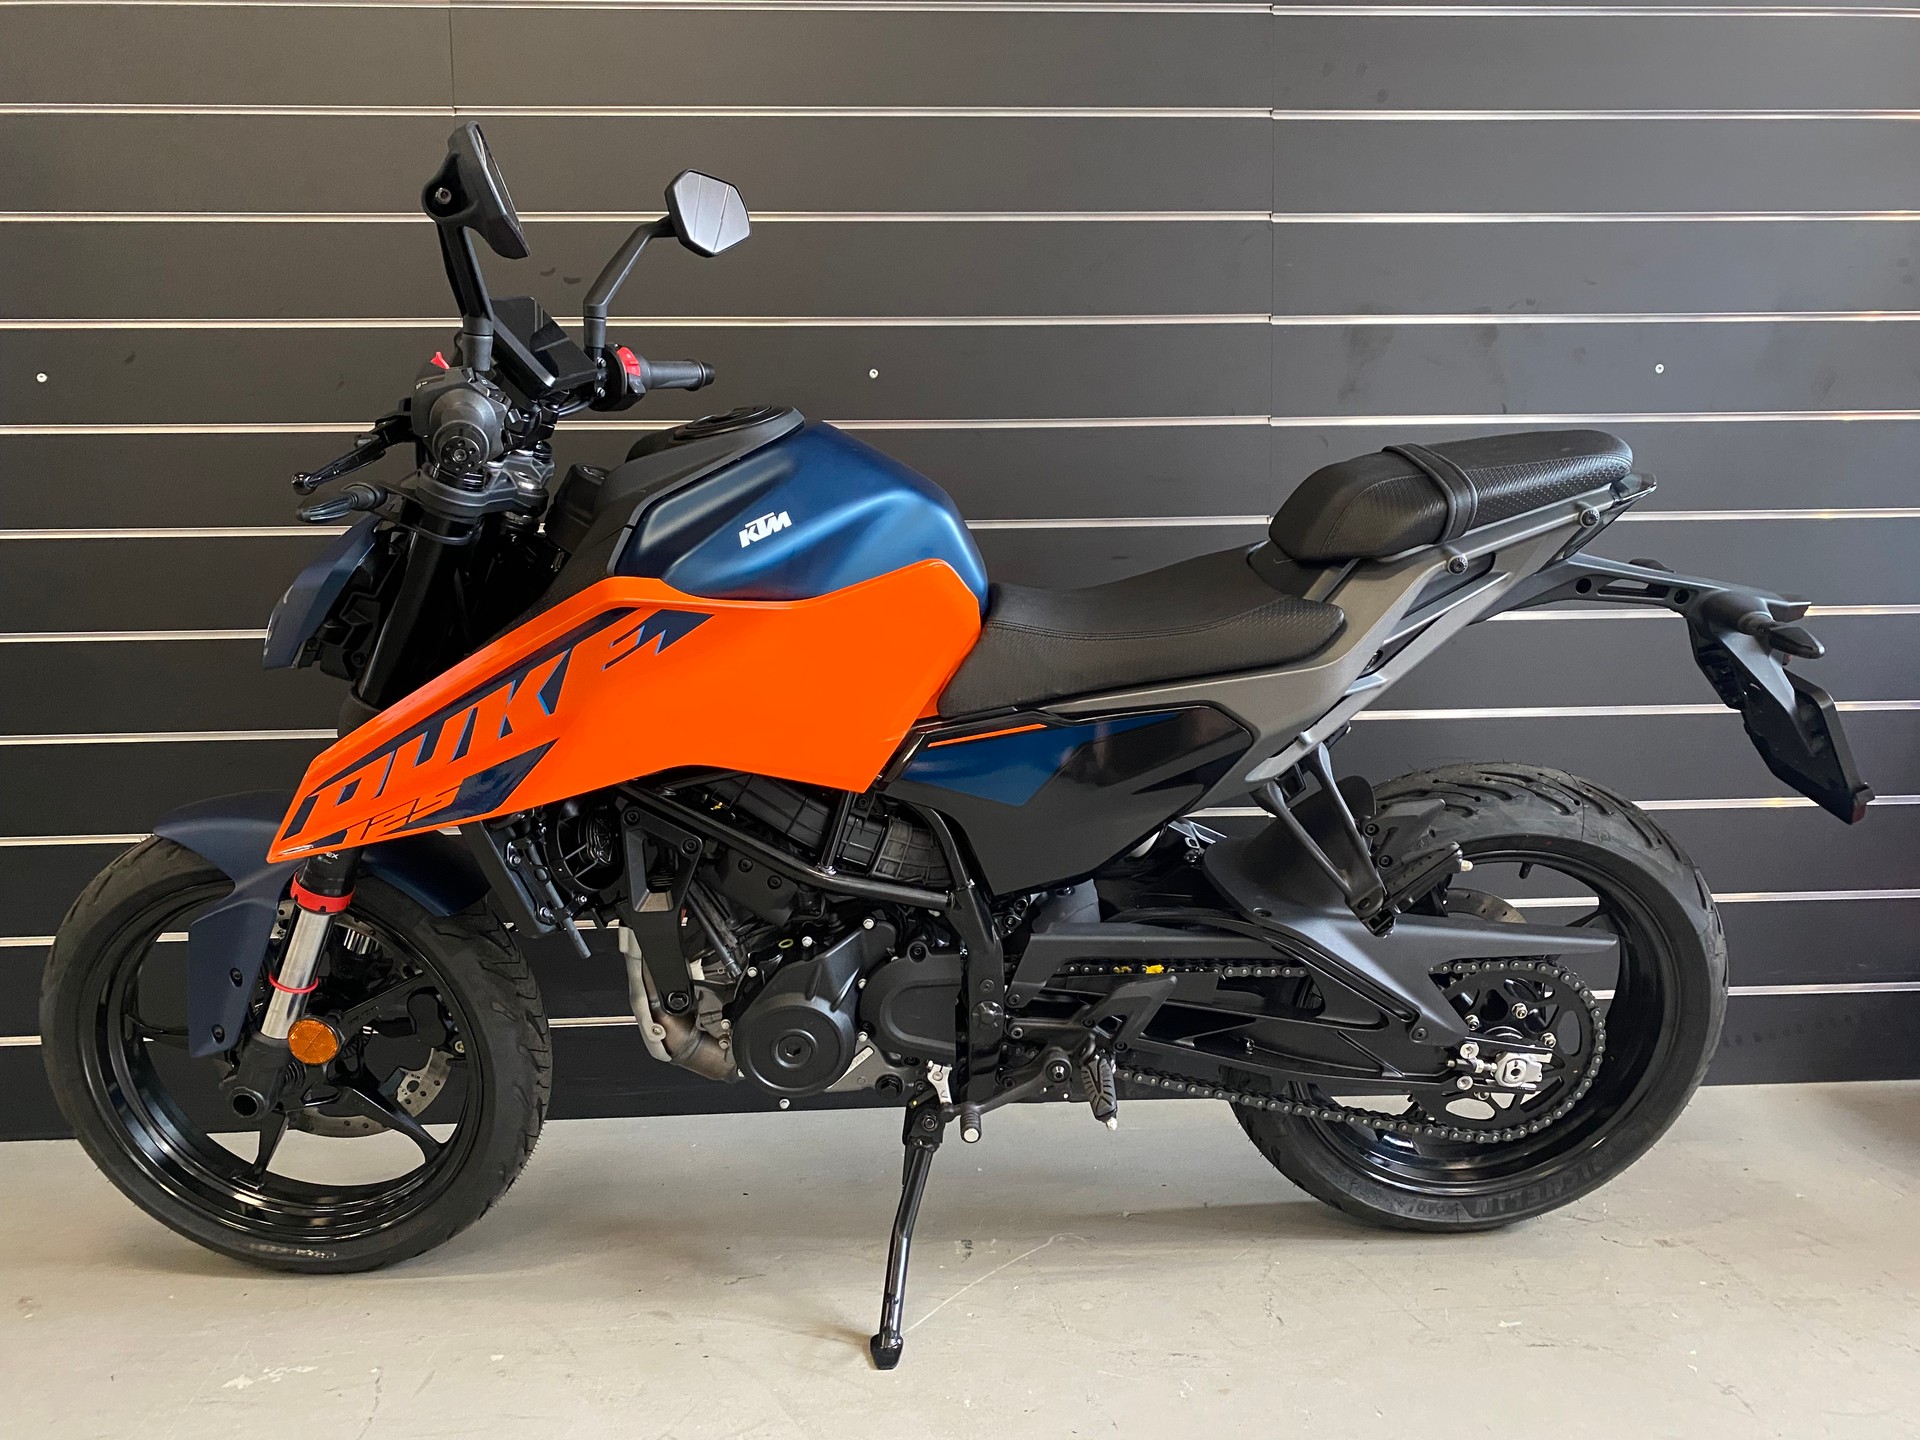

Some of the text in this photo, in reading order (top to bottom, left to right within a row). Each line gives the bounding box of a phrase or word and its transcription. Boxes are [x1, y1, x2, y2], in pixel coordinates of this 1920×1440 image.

[738, 510, 793, 549] KTM
[288, 607, 690, 838] DUKE
[341, 785, 461, 843] 125
